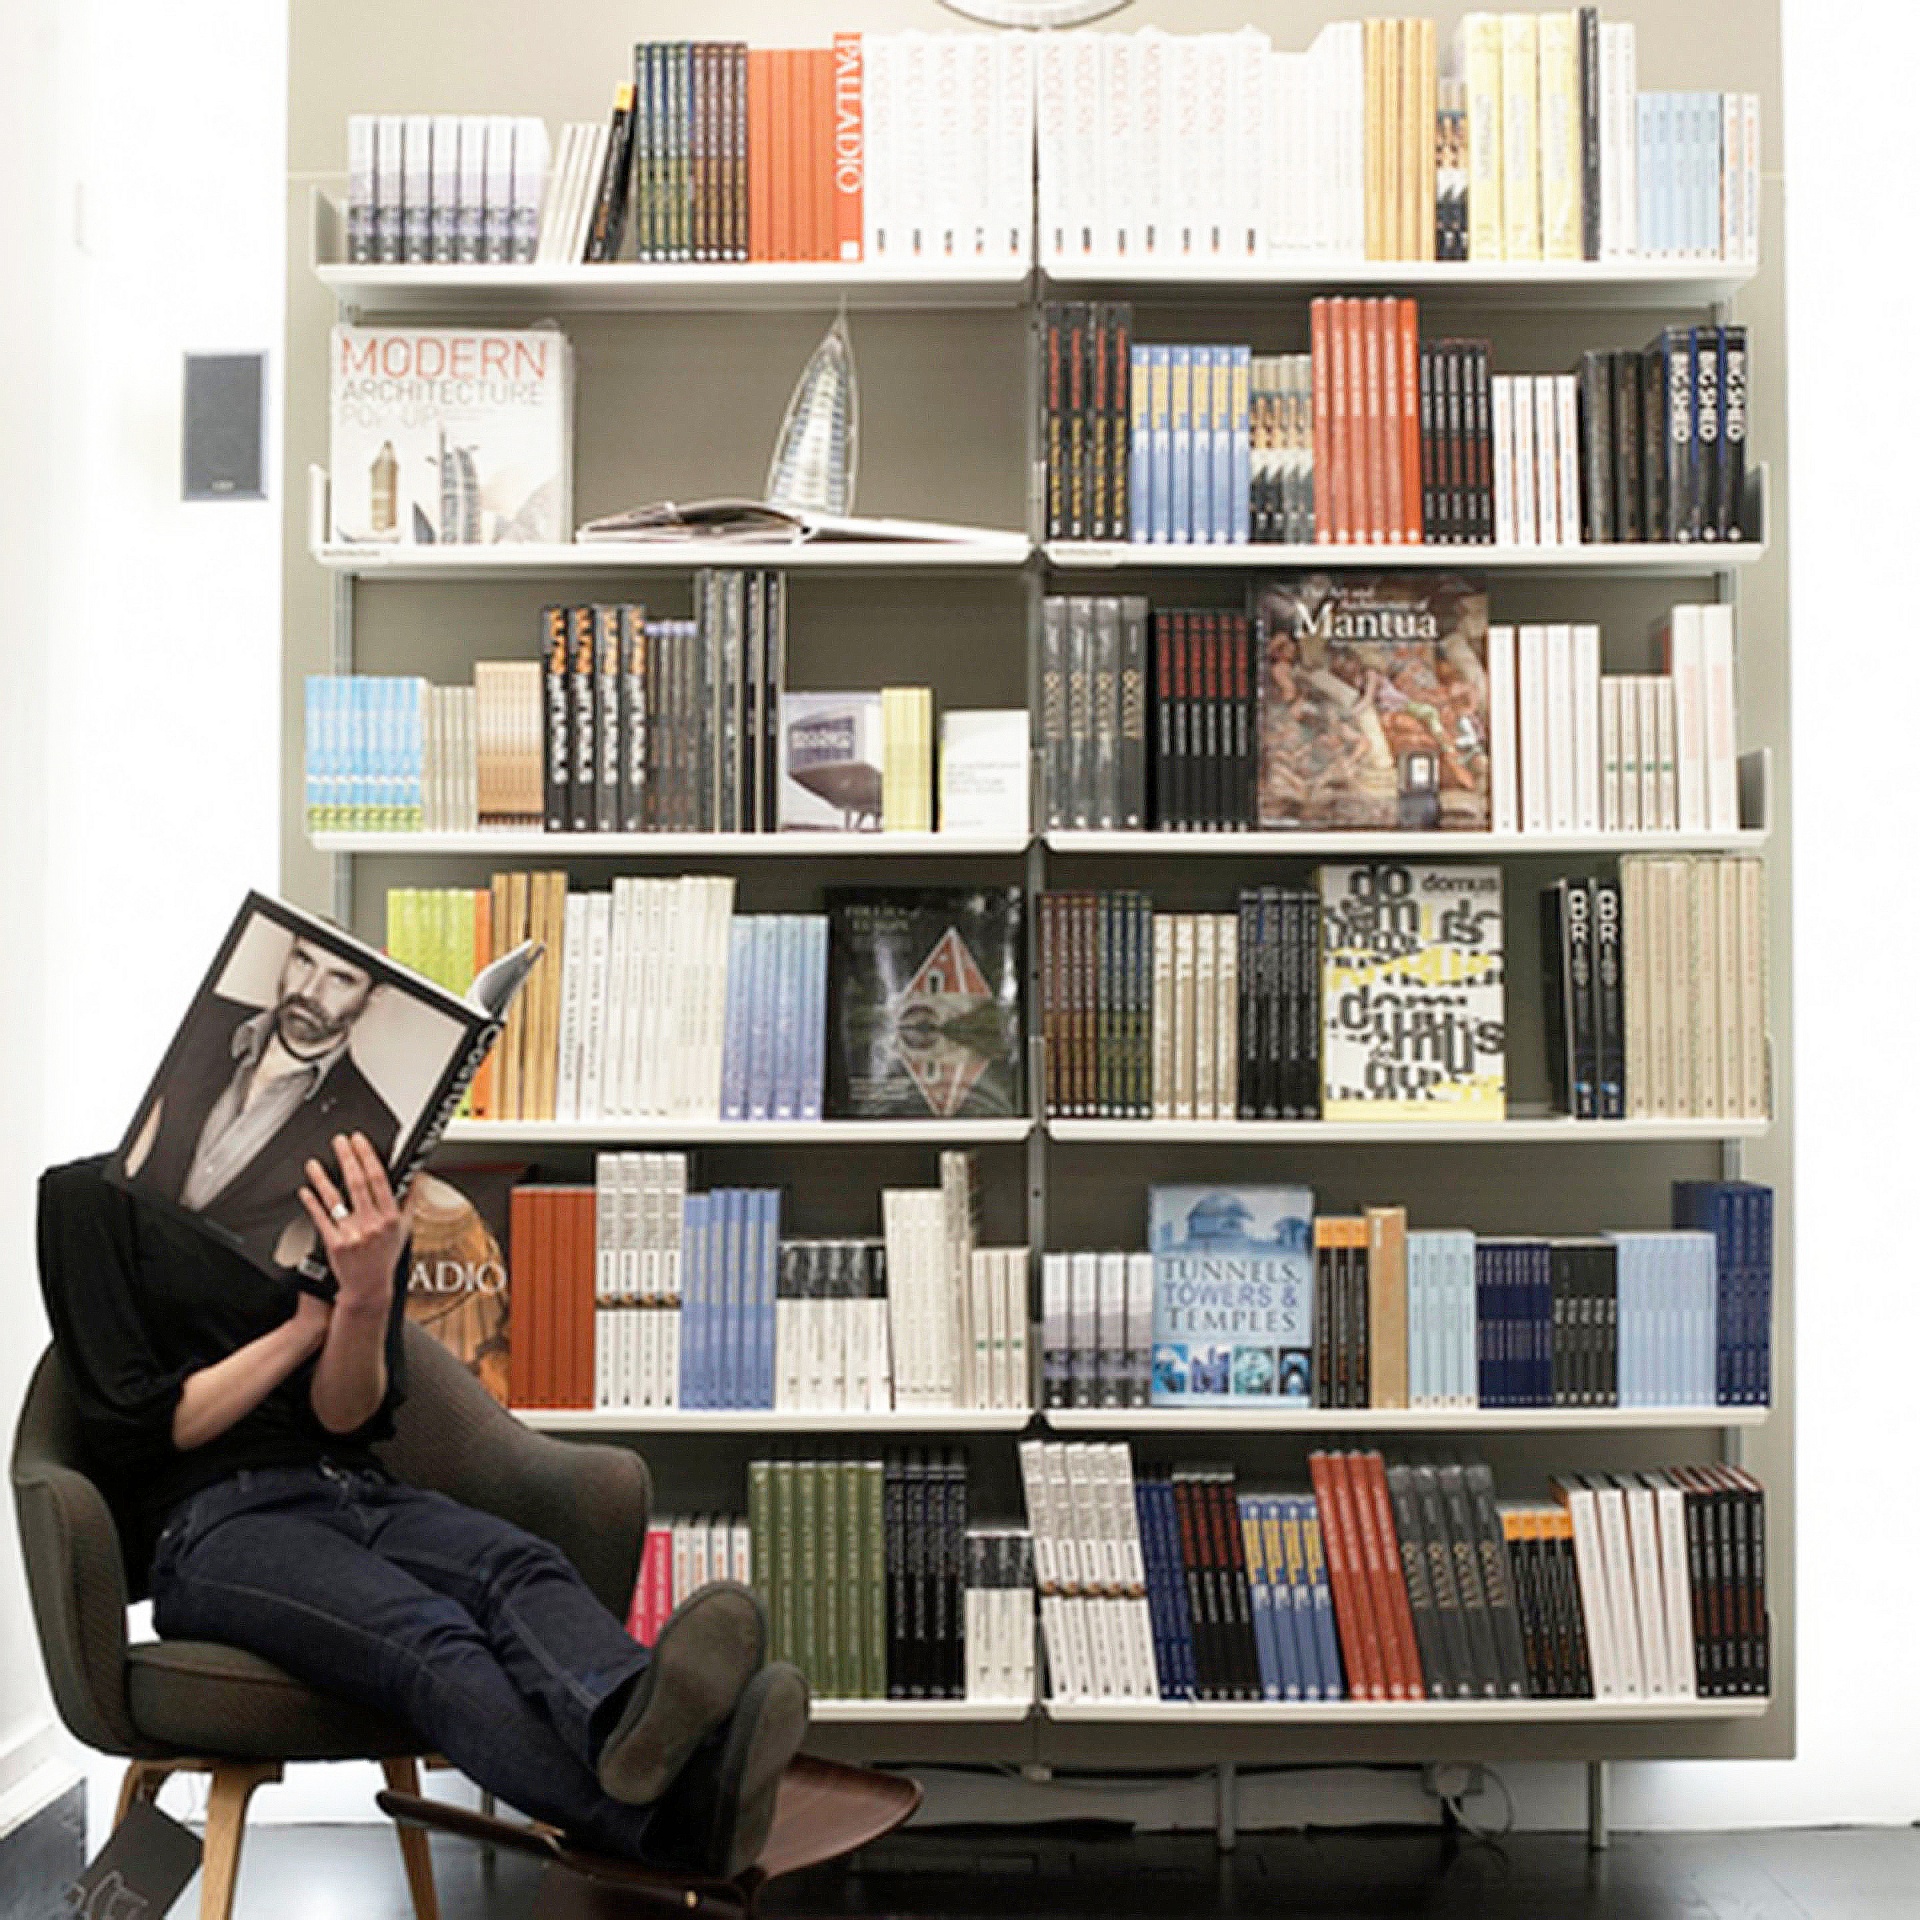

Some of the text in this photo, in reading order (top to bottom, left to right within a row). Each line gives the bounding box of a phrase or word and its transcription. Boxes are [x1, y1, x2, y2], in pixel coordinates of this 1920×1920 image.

[836, 39, 862, 193] PALLADIO
[341, 336, 547, 379] MODERN
[341, 379, 543, 405] ARCHITECTURE
[1294, 600, 1438, 639] Mantua
[1421, 872, 1498, 893] domus
[1164, 1282, 1298, 1308] TOWERS &
[1165, 1307, 1298, 1333] TEMPLES
